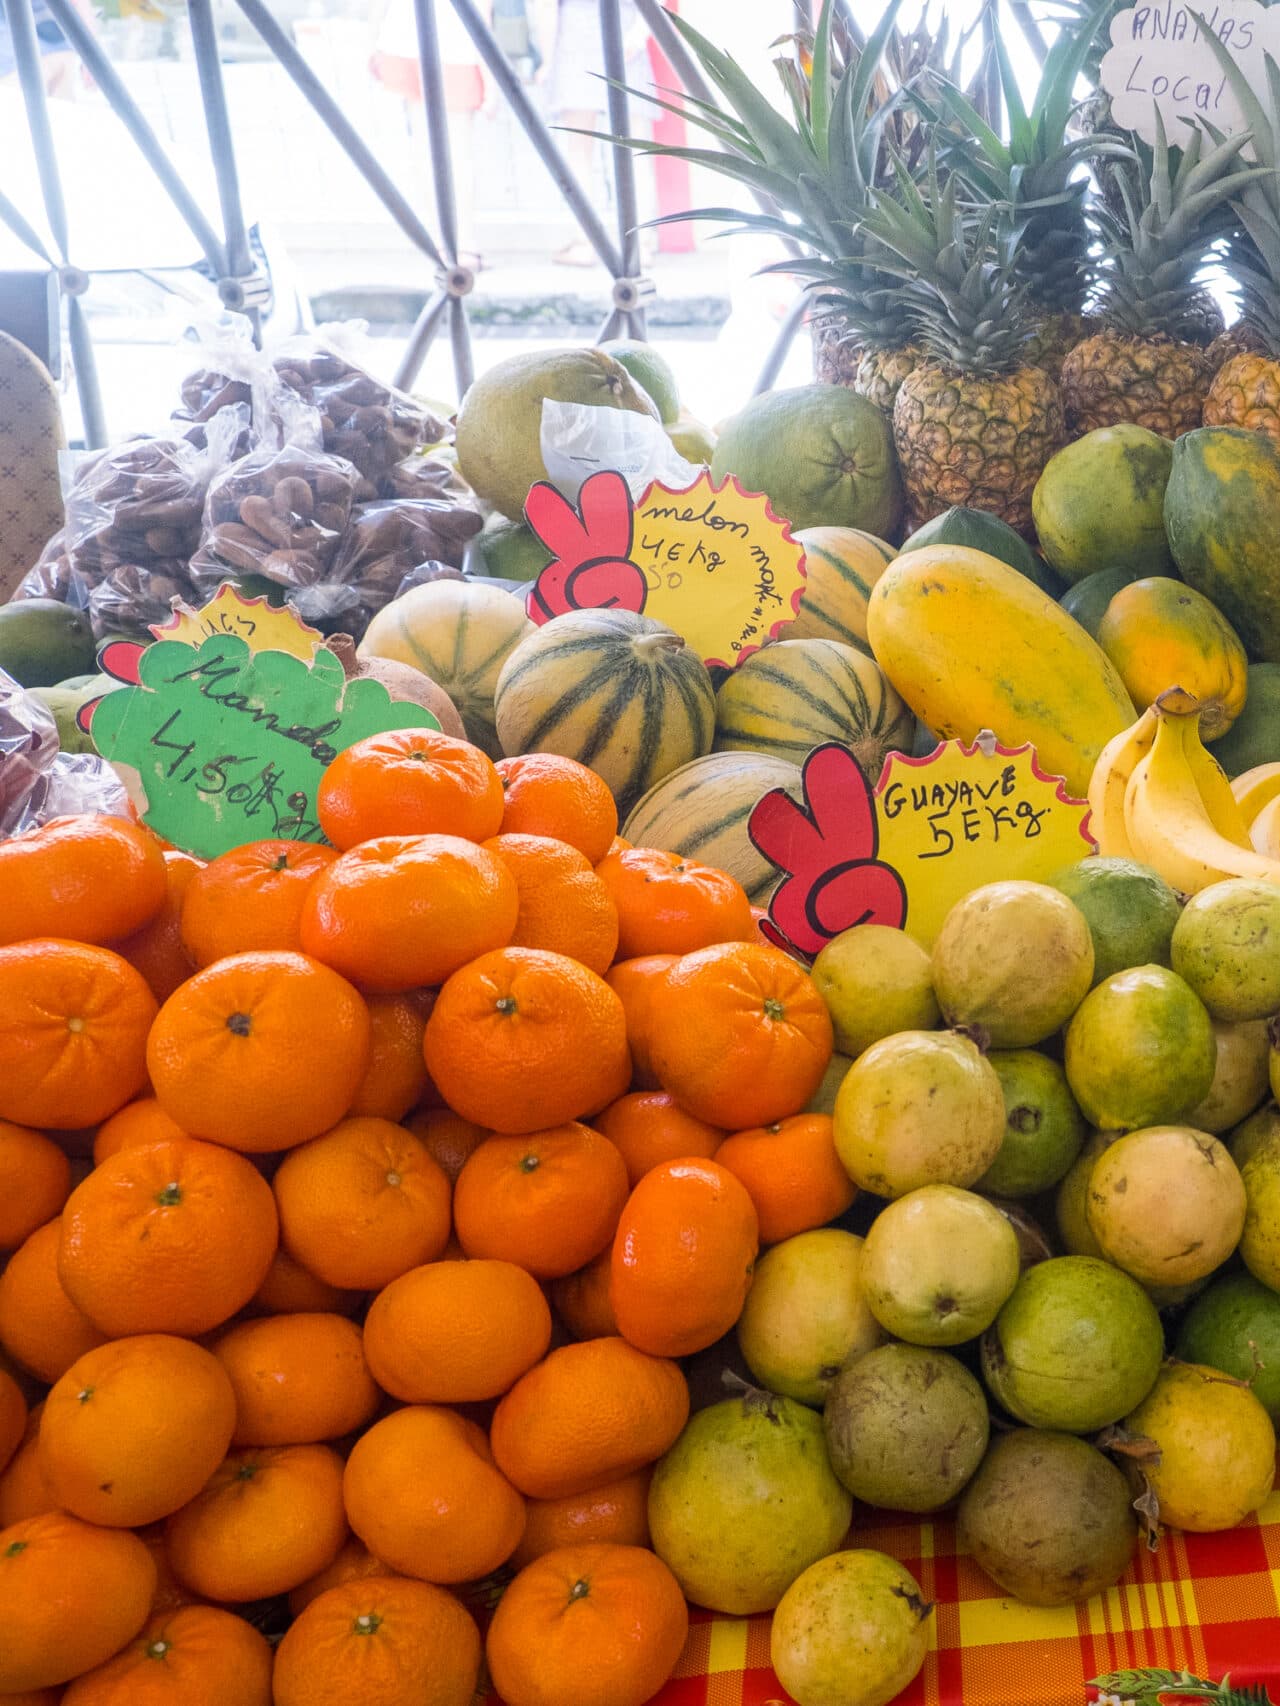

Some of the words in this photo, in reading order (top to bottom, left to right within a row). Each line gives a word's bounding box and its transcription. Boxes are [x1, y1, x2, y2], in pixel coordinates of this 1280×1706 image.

[1132, 0, 1254, 49] ANANAS
[642, 501, 749, 538] melon
[884, 765, 1016, 818] GUAYAVE
